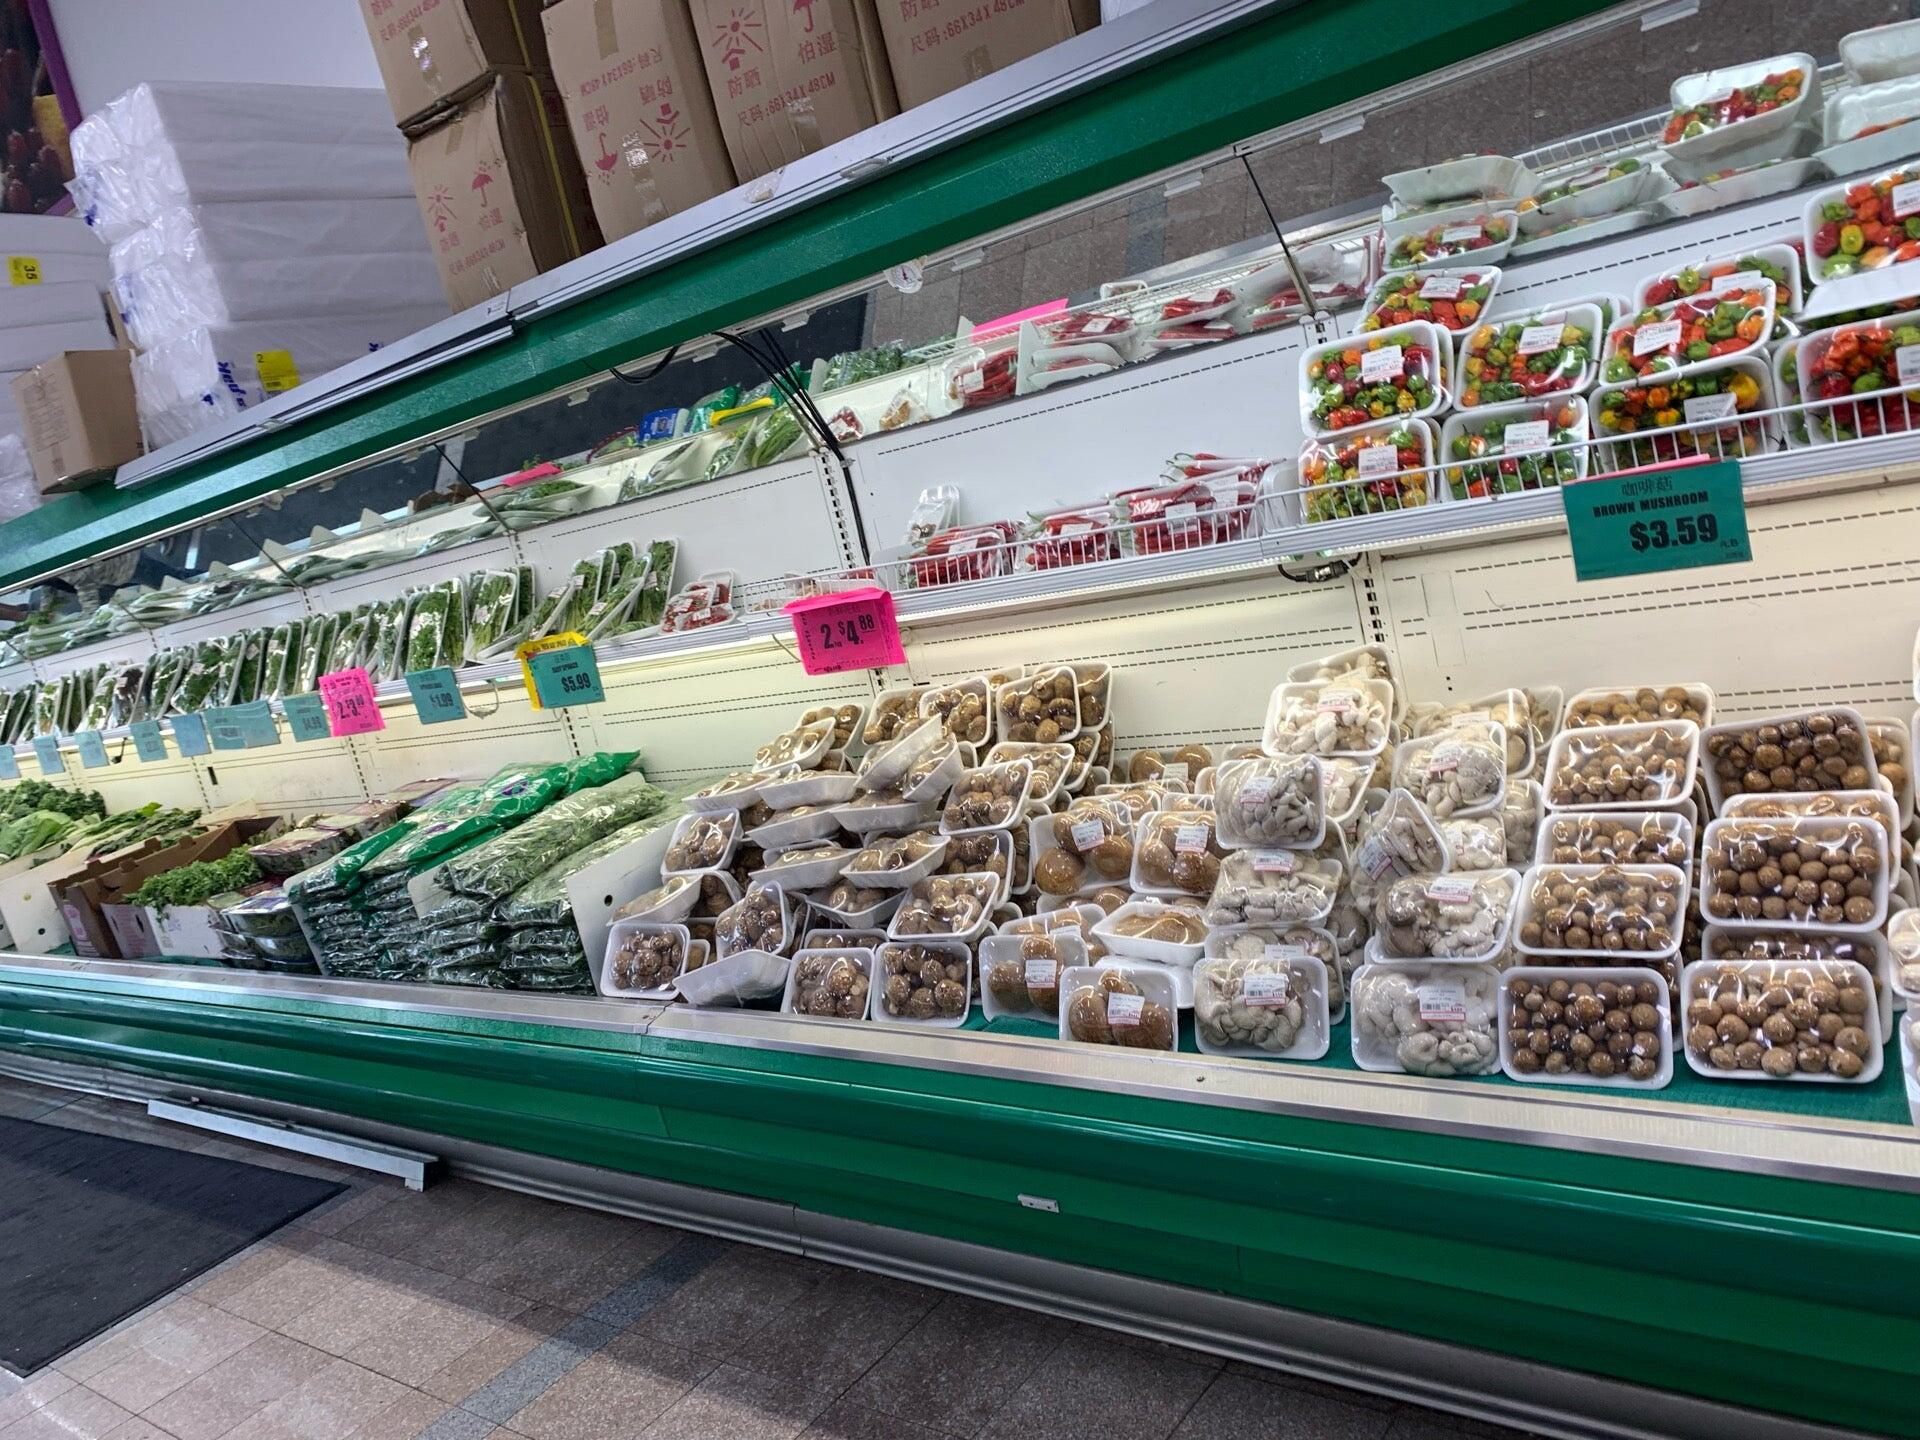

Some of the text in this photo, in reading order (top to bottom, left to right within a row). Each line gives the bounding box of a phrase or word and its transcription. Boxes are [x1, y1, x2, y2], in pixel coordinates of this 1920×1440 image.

[1593, 490, 1709, 518] BROWN MUSHROOM
[1629, 513, 1718, 553] $3.59
[561, 672, 591, 694] $5.99
